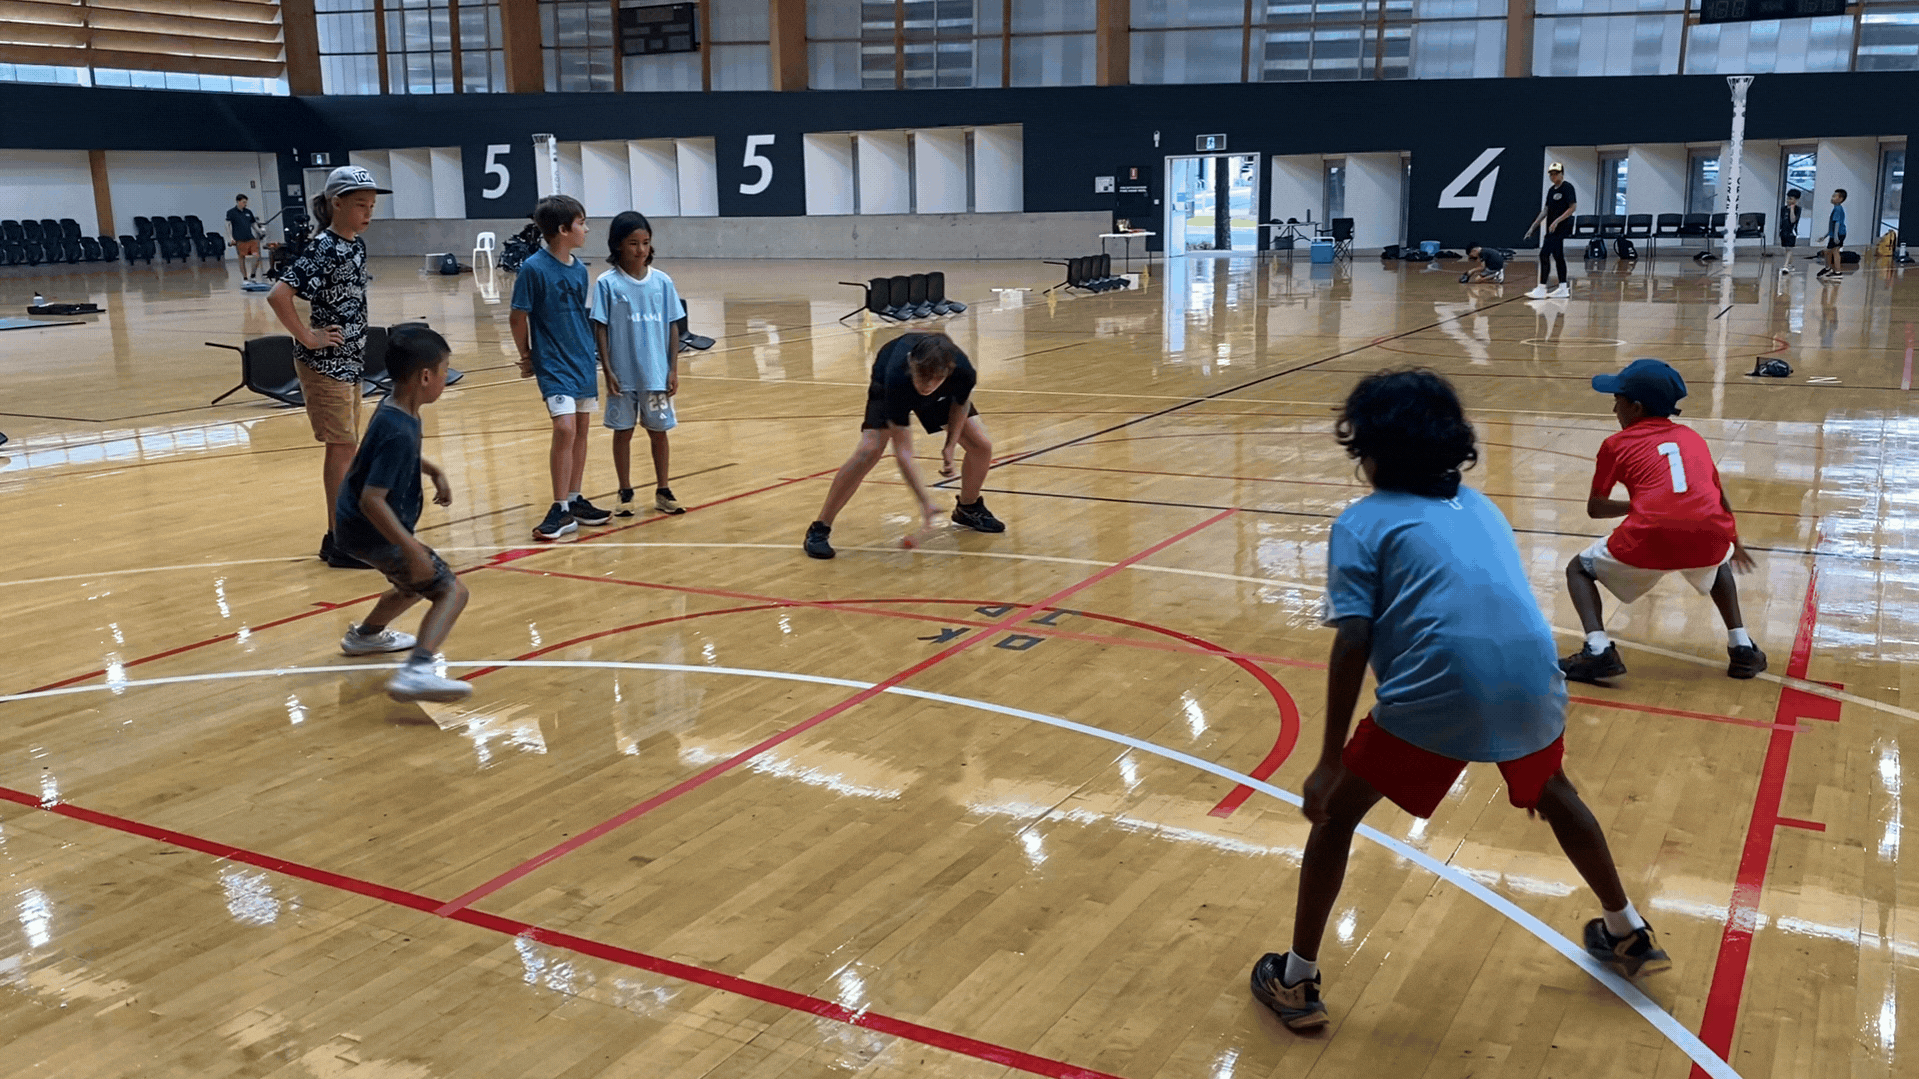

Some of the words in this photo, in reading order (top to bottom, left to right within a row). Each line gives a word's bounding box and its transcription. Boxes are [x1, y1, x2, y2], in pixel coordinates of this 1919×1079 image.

[483, 145, 510, 198] 5
[740, 134, 775, 194] 5
[1438, 148, 1505, 221] 4
[649, 394, 669, 412] 23
[1657, 442, 1687, 493] 1
